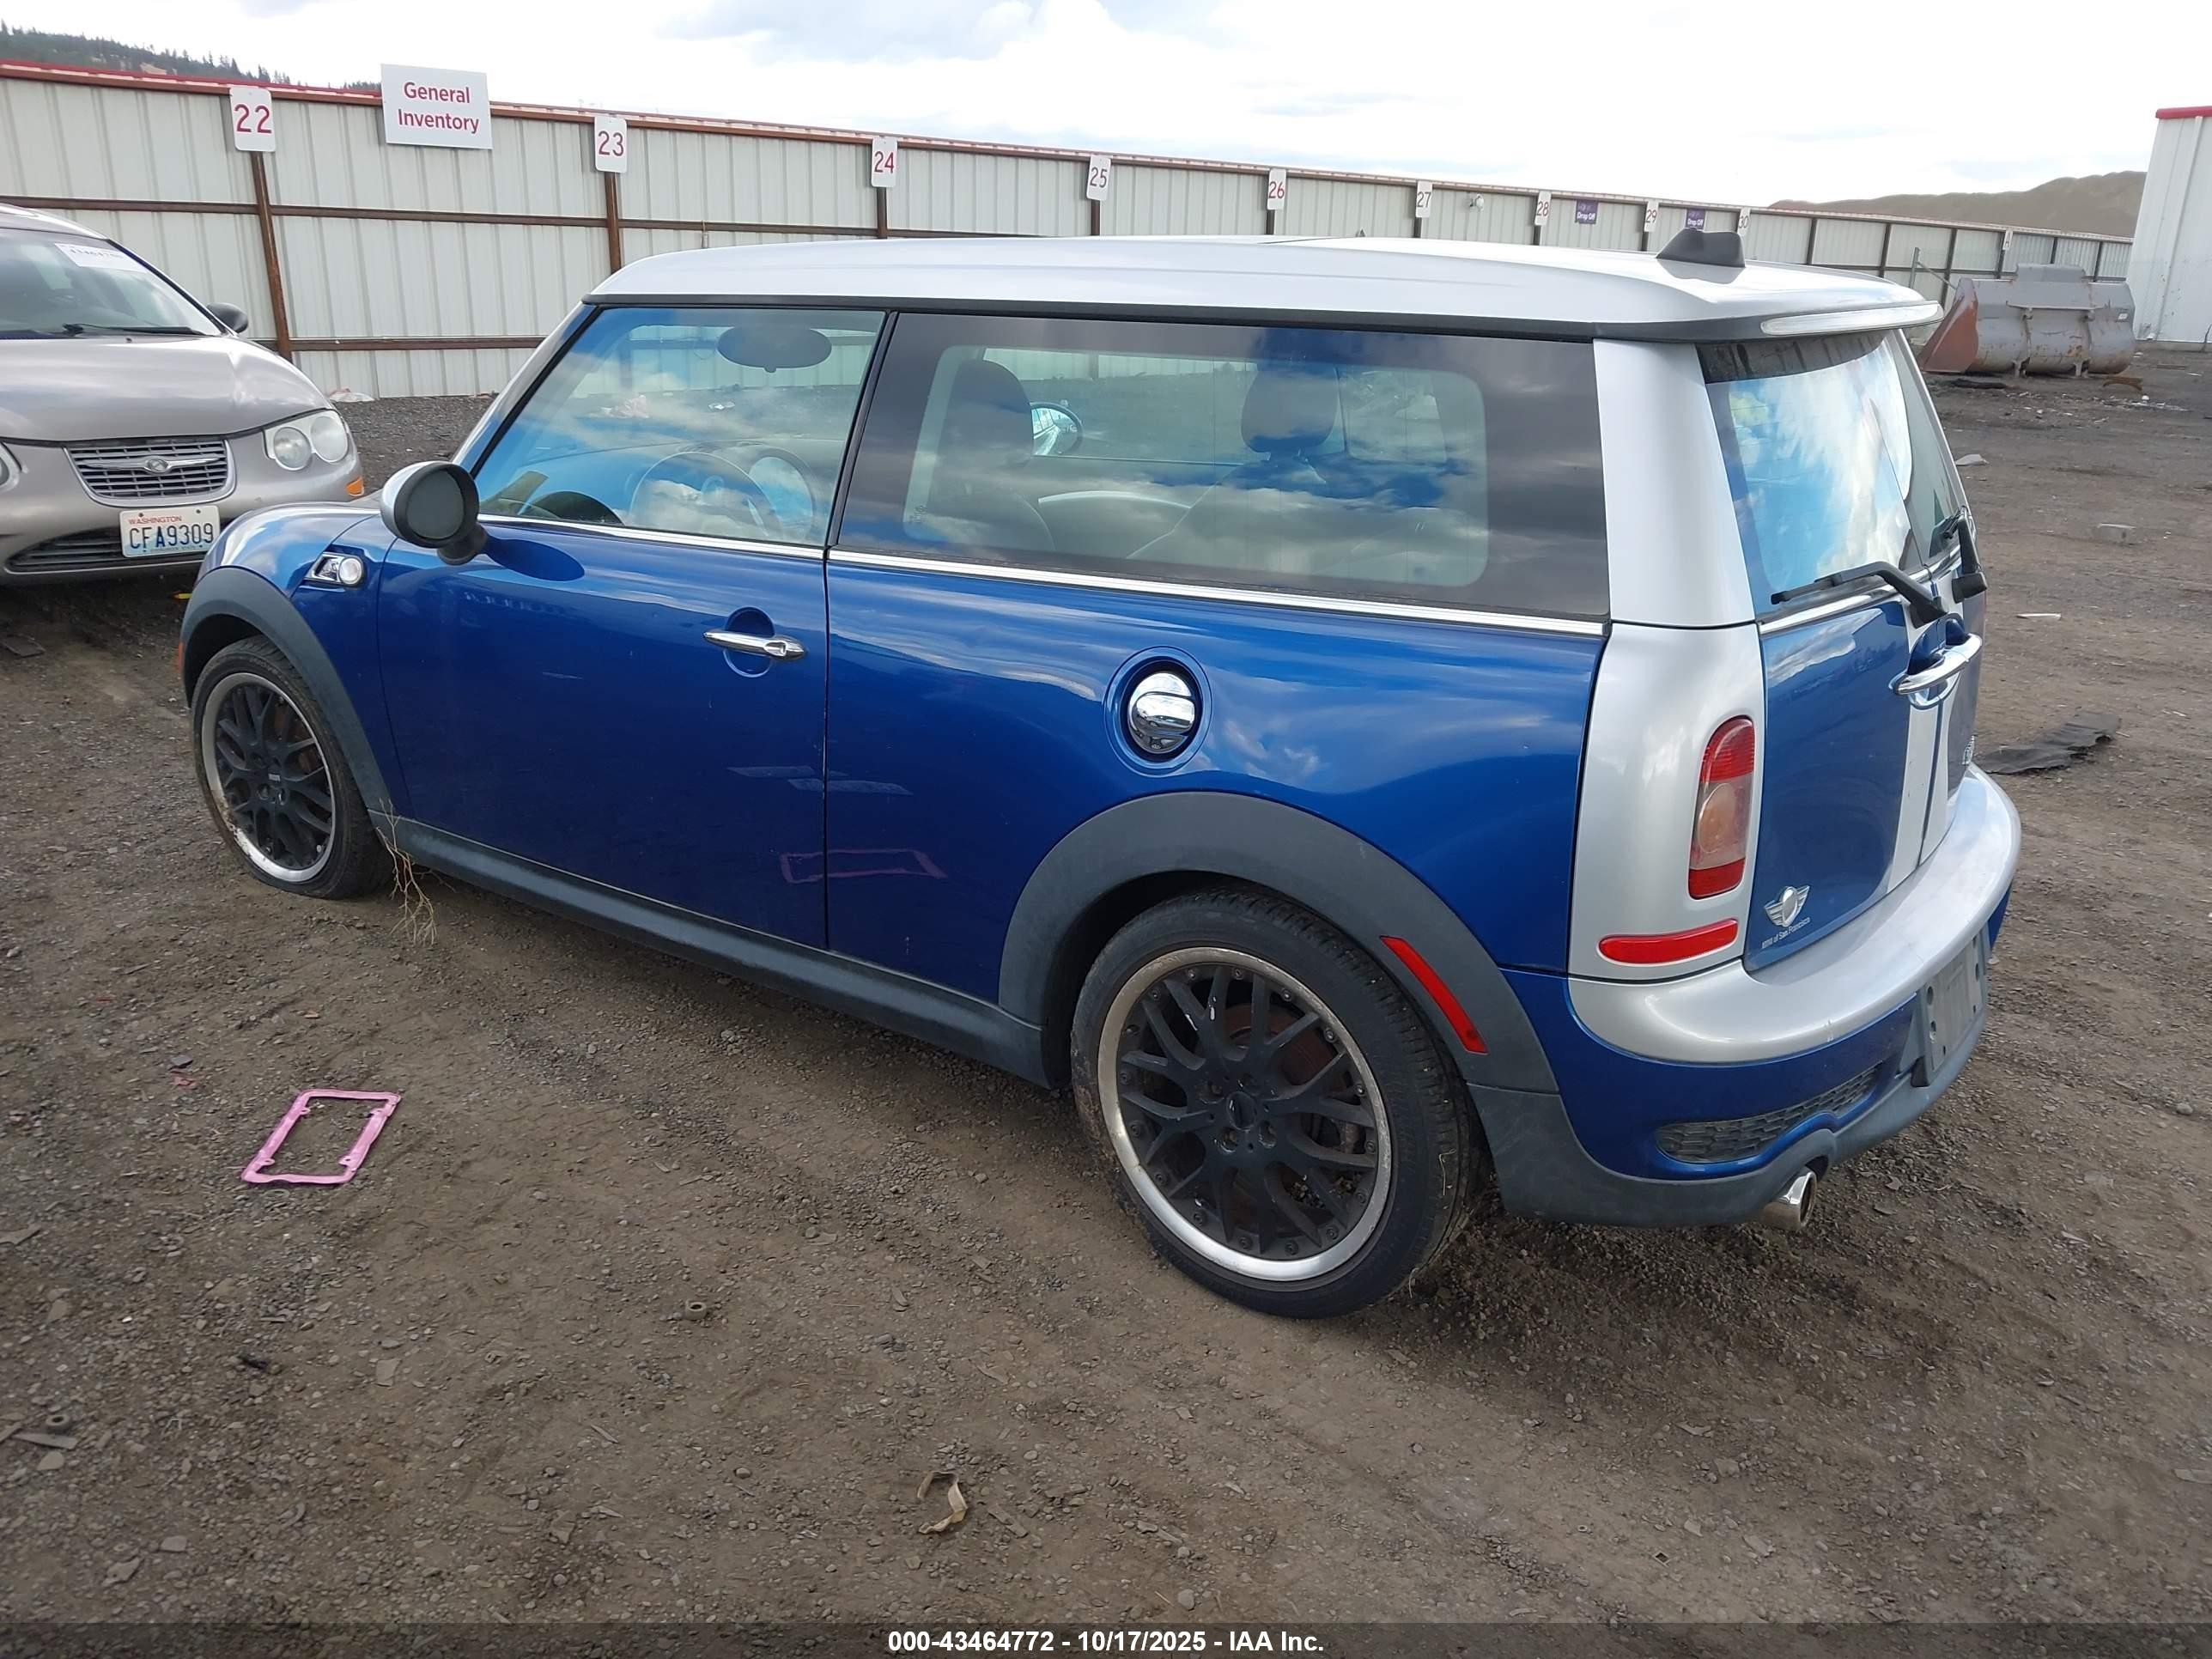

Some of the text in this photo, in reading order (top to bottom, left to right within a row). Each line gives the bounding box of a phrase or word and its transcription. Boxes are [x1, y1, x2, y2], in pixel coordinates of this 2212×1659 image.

[404, 82, 470, 104] General
[234, 104, 272, 134] 22
[398, 108, 479, 134] Inventory
[598, 131, 624, 156] 23
[874, 150, 895, 174] 24
[1090, 167, 1108, 188] 25
[1268, 181, 1285, 199] 26
[1417, 191, 1431, 208] 27
[1536, 201, 1549, 216] 28
[1646, 209, 1657, 223] 29
[1739, 216, 1748, 228] 30
[128, 515, 182, 526] WASHINGTON
[130, 522, 215, 550] CFA9309
